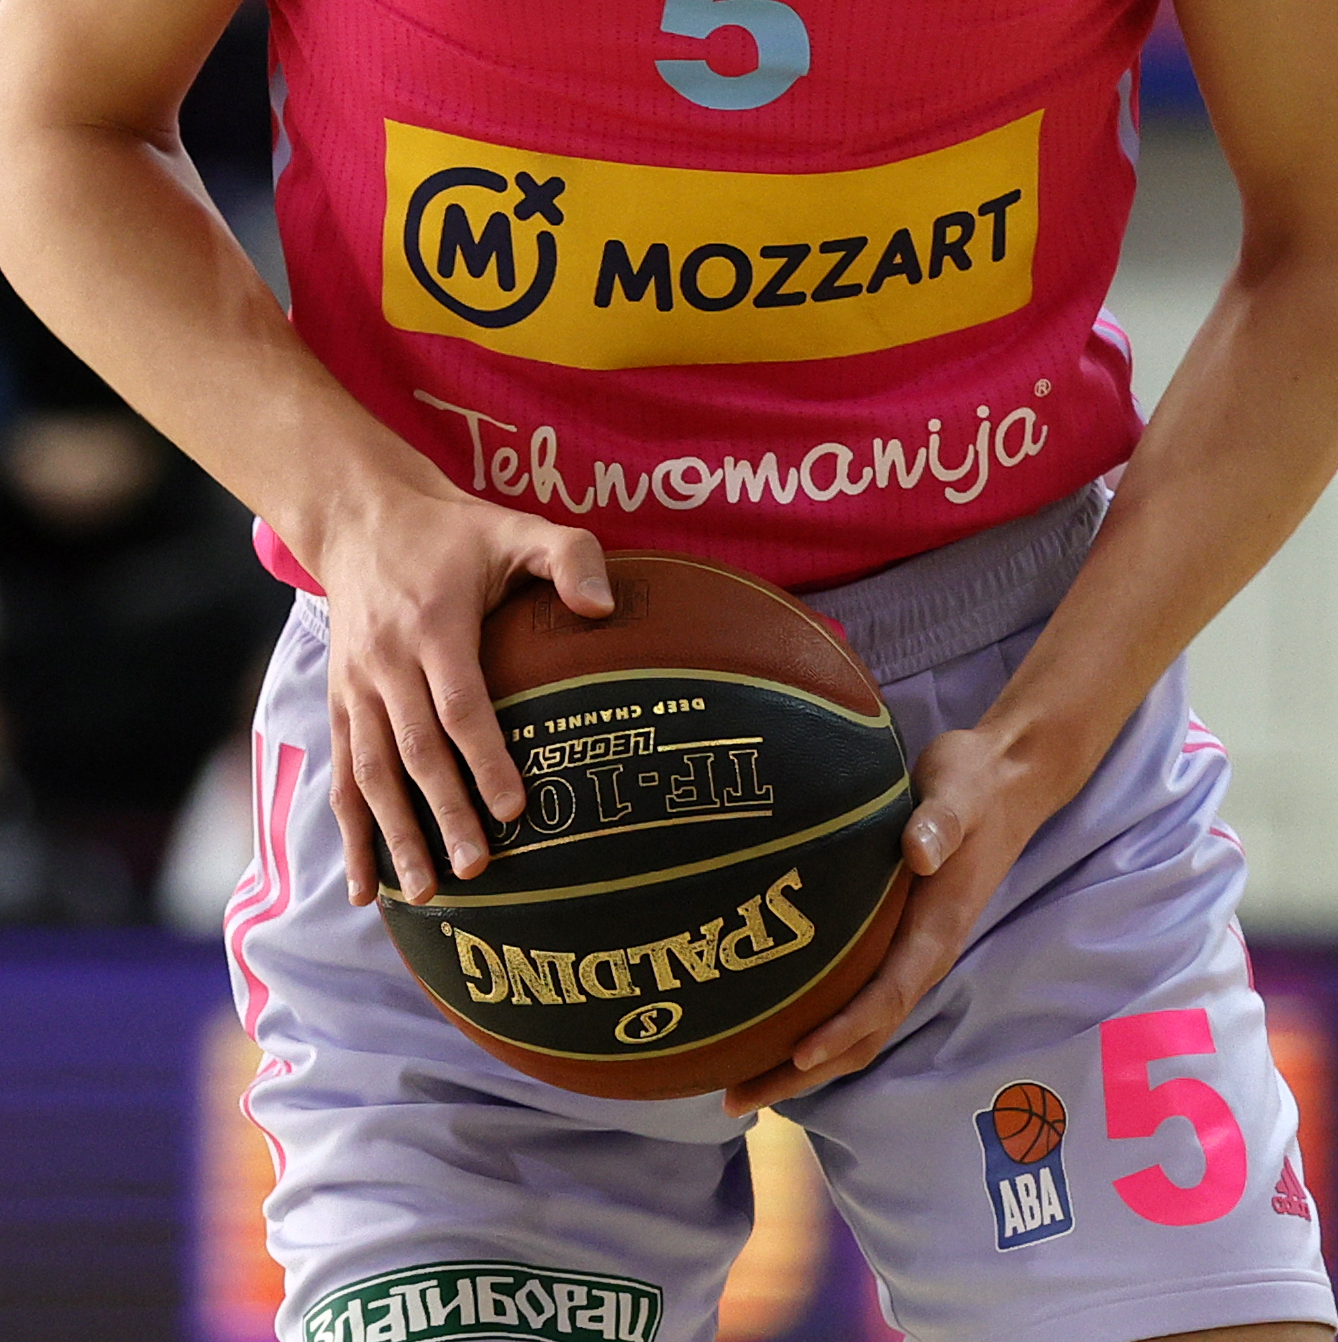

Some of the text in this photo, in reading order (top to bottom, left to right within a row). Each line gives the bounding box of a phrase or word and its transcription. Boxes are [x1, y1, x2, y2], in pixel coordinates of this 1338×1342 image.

[593, 188, 1022, 313] MOZZART
[544, 706, 643, 734] CHANNEL
[653, 697, 706, 715] DEEP
[522, 726, 656, 778] LEGACY
[453, 866, 815, 1006] SPALDING
[1099, 1007, 1248, 1227] 5
[998, 1166, 1065, 1239] ABA
